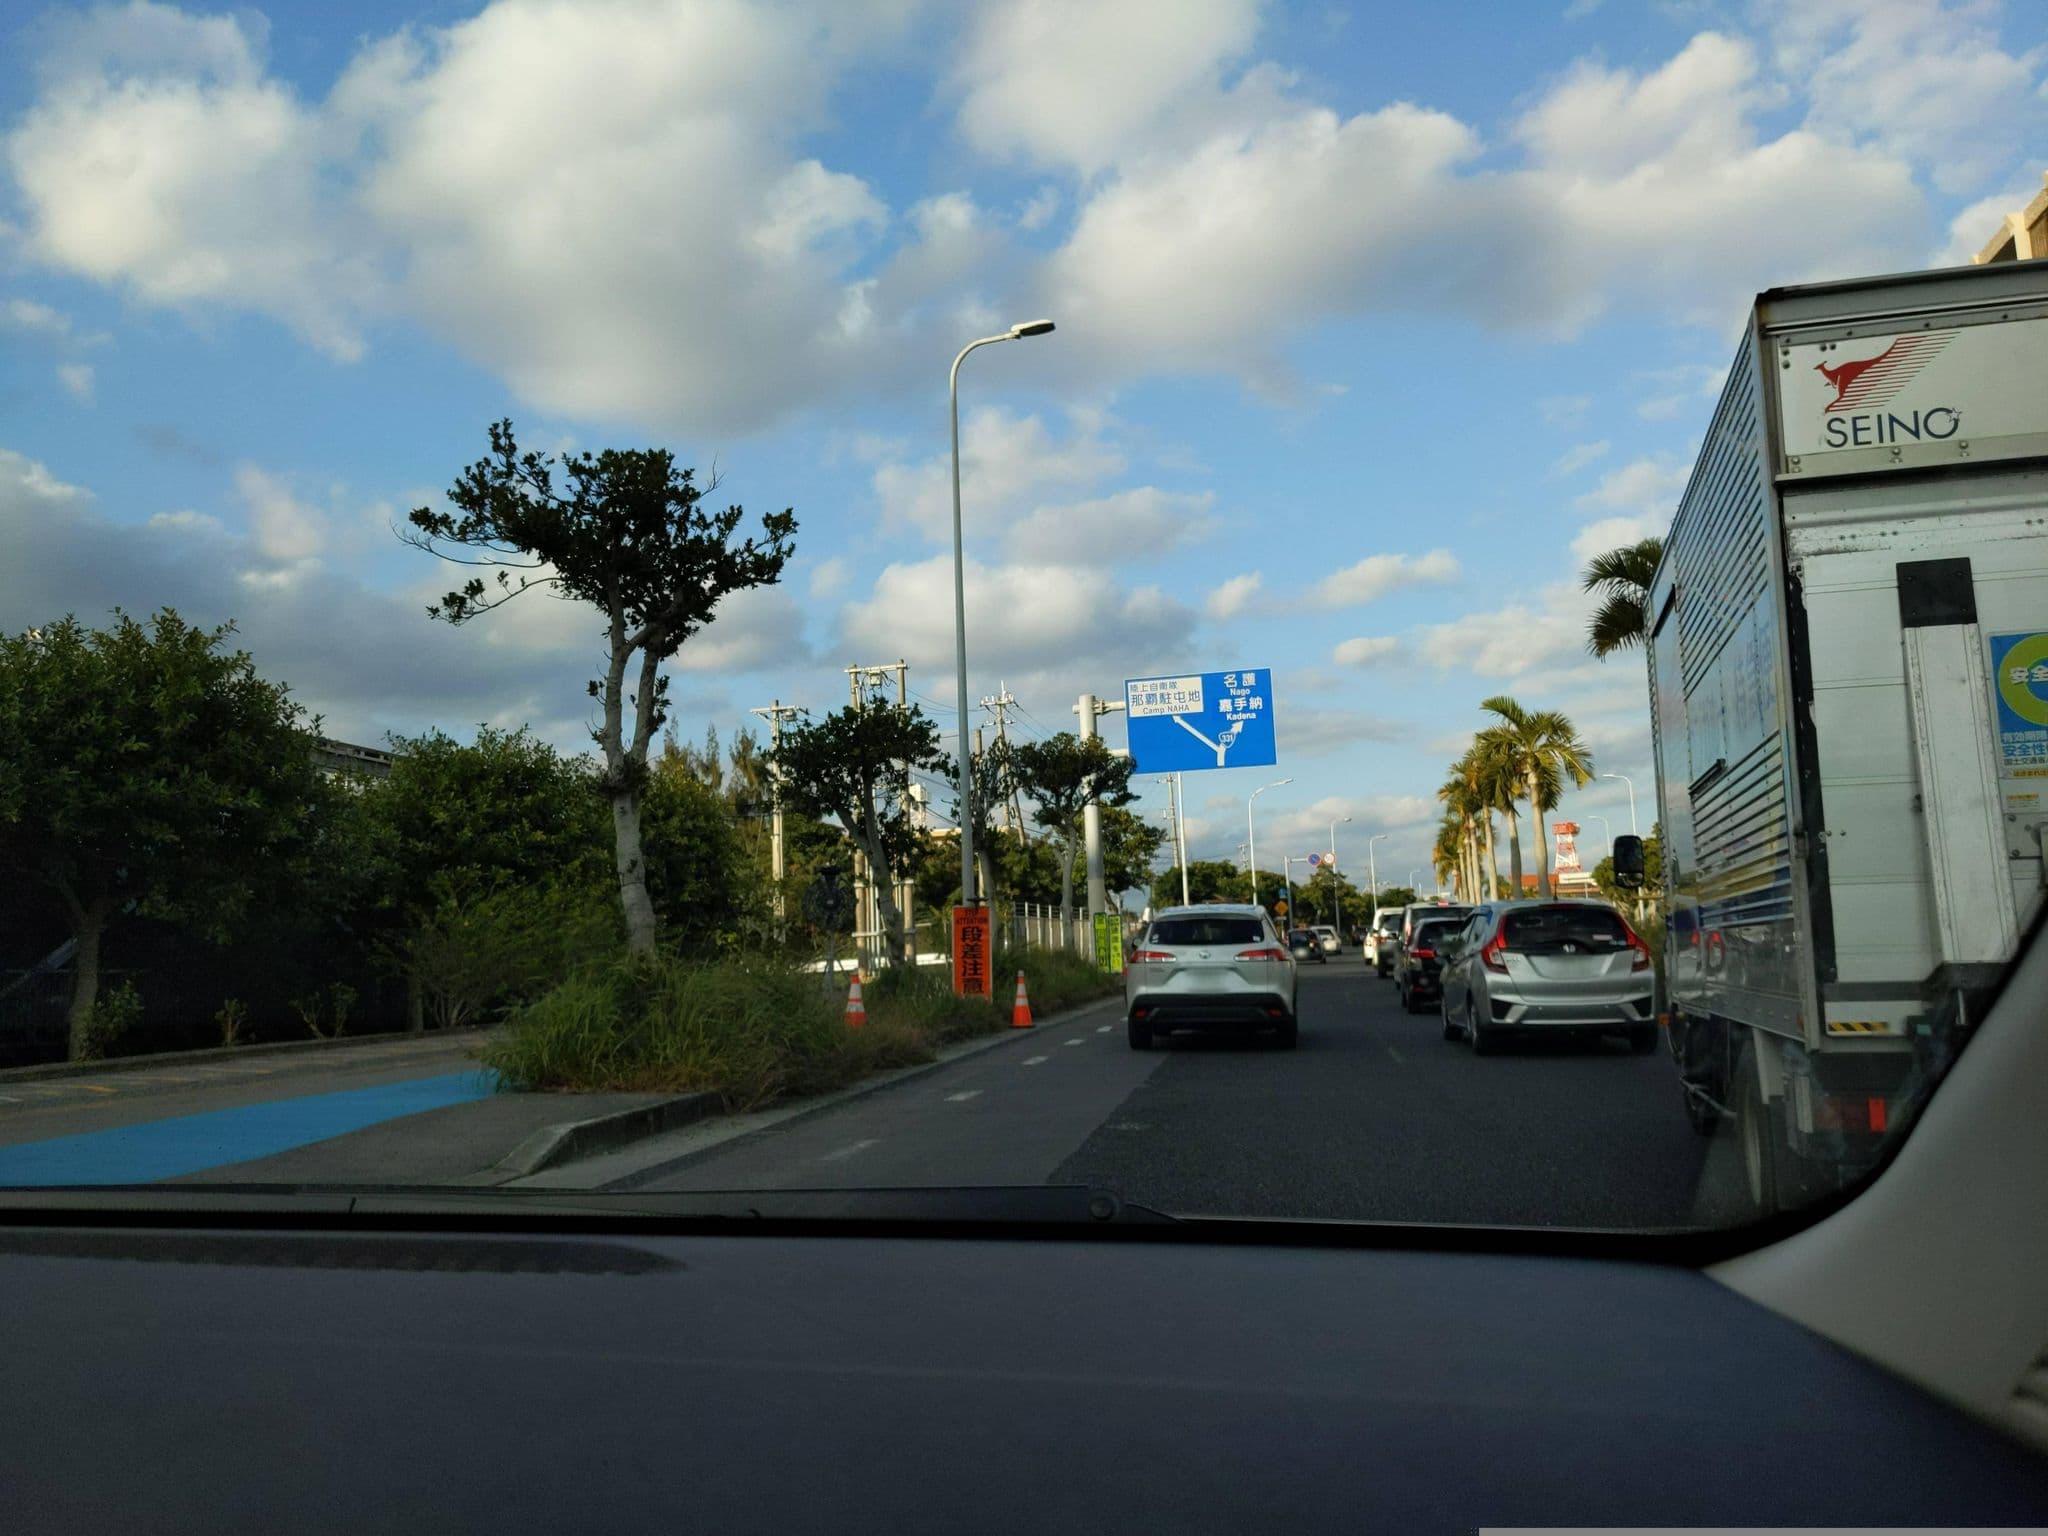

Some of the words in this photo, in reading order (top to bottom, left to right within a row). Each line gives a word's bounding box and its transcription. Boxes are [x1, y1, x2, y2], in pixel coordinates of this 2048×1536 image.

[1826, 407, 1960, 448] SEINO
[1223, 672, 1257, 688] 名護
[1130, 690, 1201, 707] 那覇駐屯地
[1230, 688, 1251, 696] Nago
[1142, 707, 1165, 716] Camp
[1167, 704, 1191, 713] NAHA
[1218, 696, 1263, 712] 嘉手納
[1226, 712, 1257, 721] Kadena
[1221, 734, 1233, 743] 331
[2003, 743, 2048, 757] 安全性
[2004, 757, 2048, 766] 国土交通省
[960, 926, 984, 993] 段差注意
